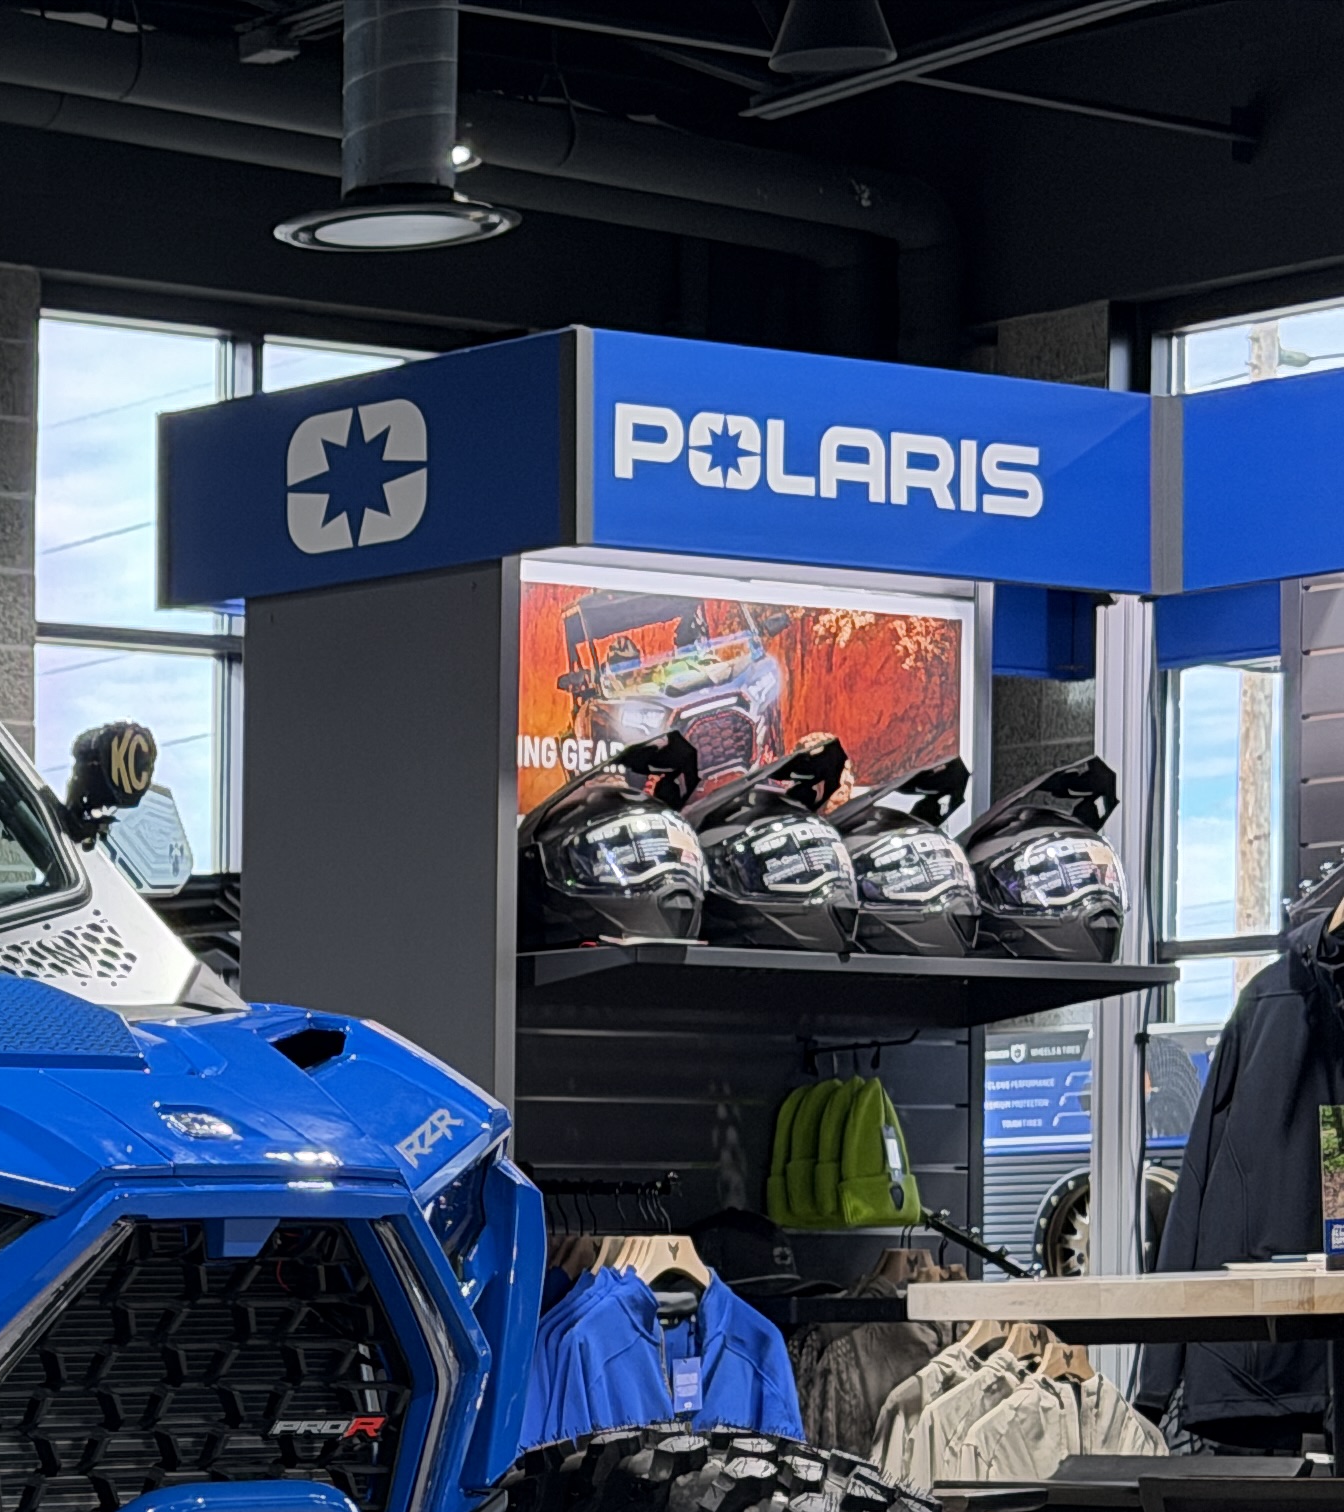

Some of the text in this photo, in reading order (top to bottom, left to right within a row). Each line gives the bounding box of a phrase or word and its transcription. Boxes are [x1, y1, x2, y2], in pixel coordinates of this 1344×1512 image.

[614, 402, 1044, 518] POLARIS
[111, 729, 149, 794] KC
[517, 734, 557, 769] ING
[395, 1108, 465, 1168] RZR
[269, 1416, 386, 1439] PRO R
